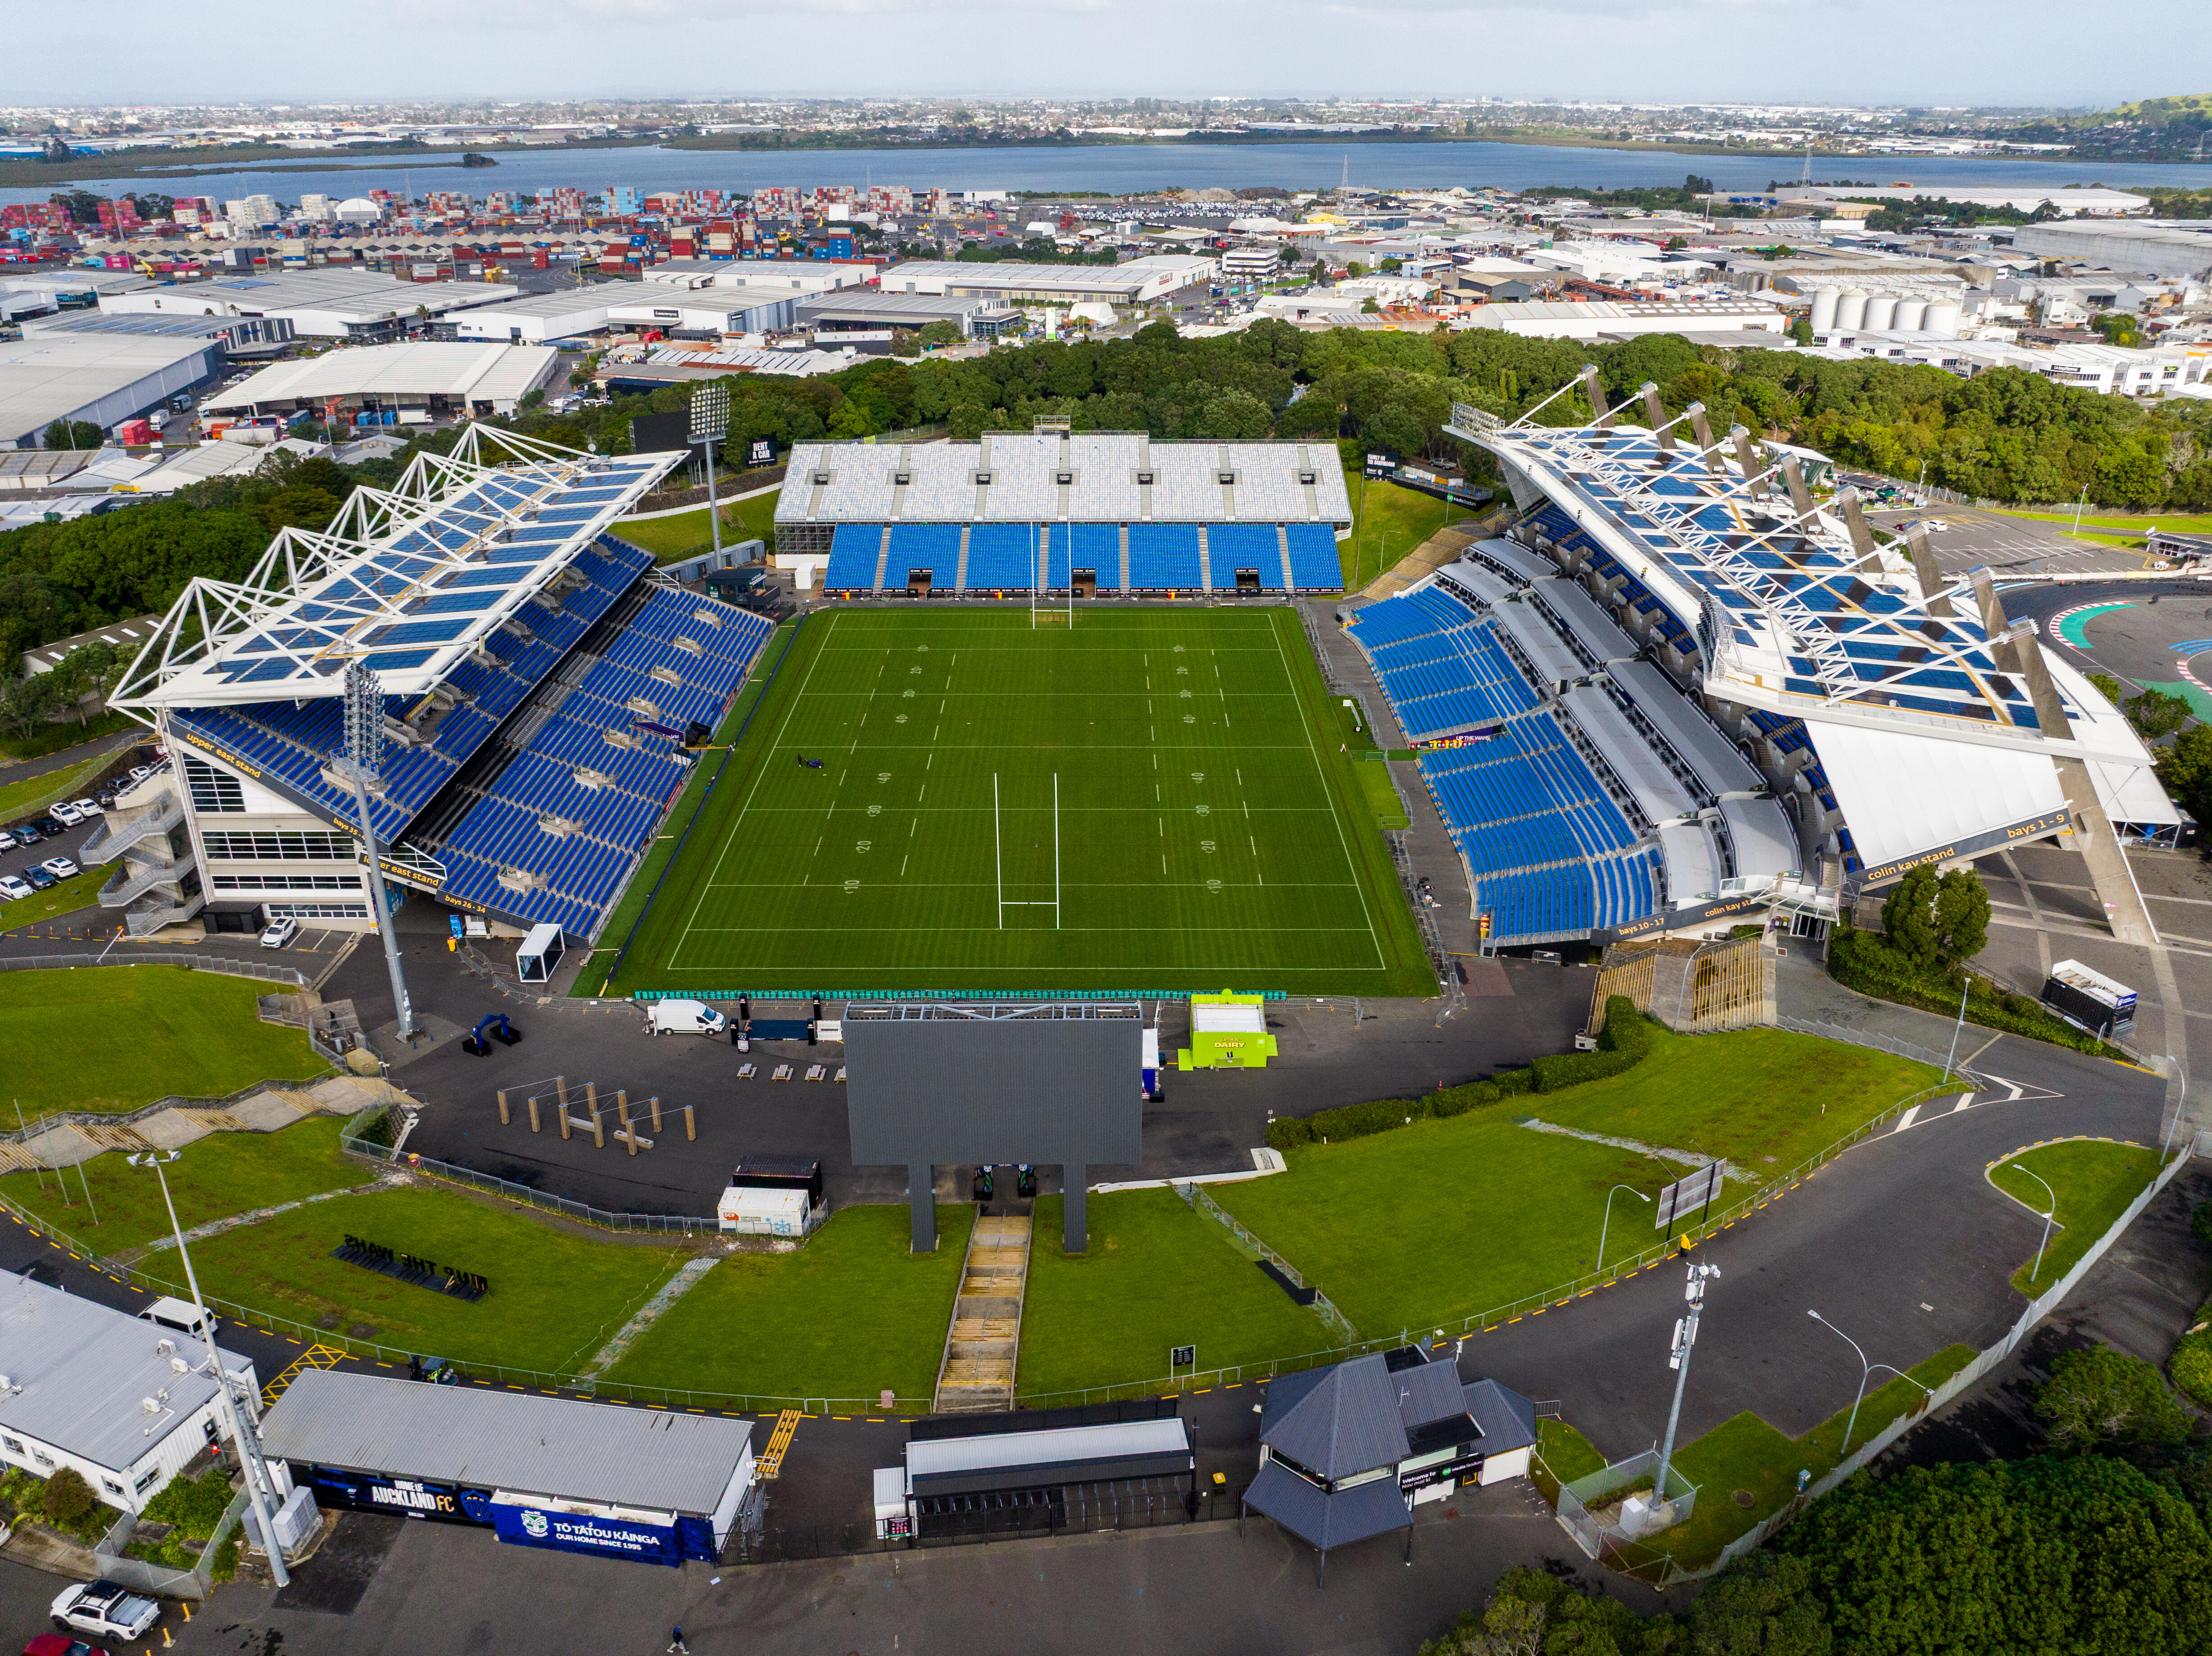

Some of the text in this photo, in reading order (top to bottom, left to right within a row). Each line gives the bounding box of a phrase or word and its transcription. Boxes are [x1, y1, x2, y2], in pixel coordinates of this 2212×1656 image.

[753, 442, 768, 451] RENT
[753, 450, 770, 459] A CAR
[186, 733, 261, 778] upper east stand
[877, 773, 891, 781] 40
[1191, 773, 1204, 781] 40
[333, 817, 348, 831] bays
[349, 827, 358, 835] 35
[2007, 823, 2037, 839] bays
[2038, 819, 2047, 829] 1
[2056, 814, 2065, 823] 9
[856, 841, 871, 851] 20
[1201, 841, 1215, 851] 20
[1868, 864, 1897, 881] colin
[1921, 847, 1955, 864] stand
[391, 866, 411, 878] east
[412, 872, 439, 887] stand
[844, 880, 860, 890] 10
[1206, 880, 1222, 890] 10
[445, 895, 462, 906] bays
[476, 905, 486, 914] 34
[1705, 907, 1725, 917] colin
[1727, 903, 1740, 912] kay
[1618, 925, 1637, 935] bays
[1656, 918, 1665, 926] 17
[1402, 1473, 1429, 1484] Welcome
[394, 1480, 424, 1493] HOME OF
[372, 1486, 455, 1512] AUCKLAND FC
[553, 1523, 660, 1545] TŌ TĀTOU KĀINGA
[574, 1535, 598, 1545] HOME
[598, 1539, 622, 1547] SINCE
[623, 1543, 642, 1551] 1995
